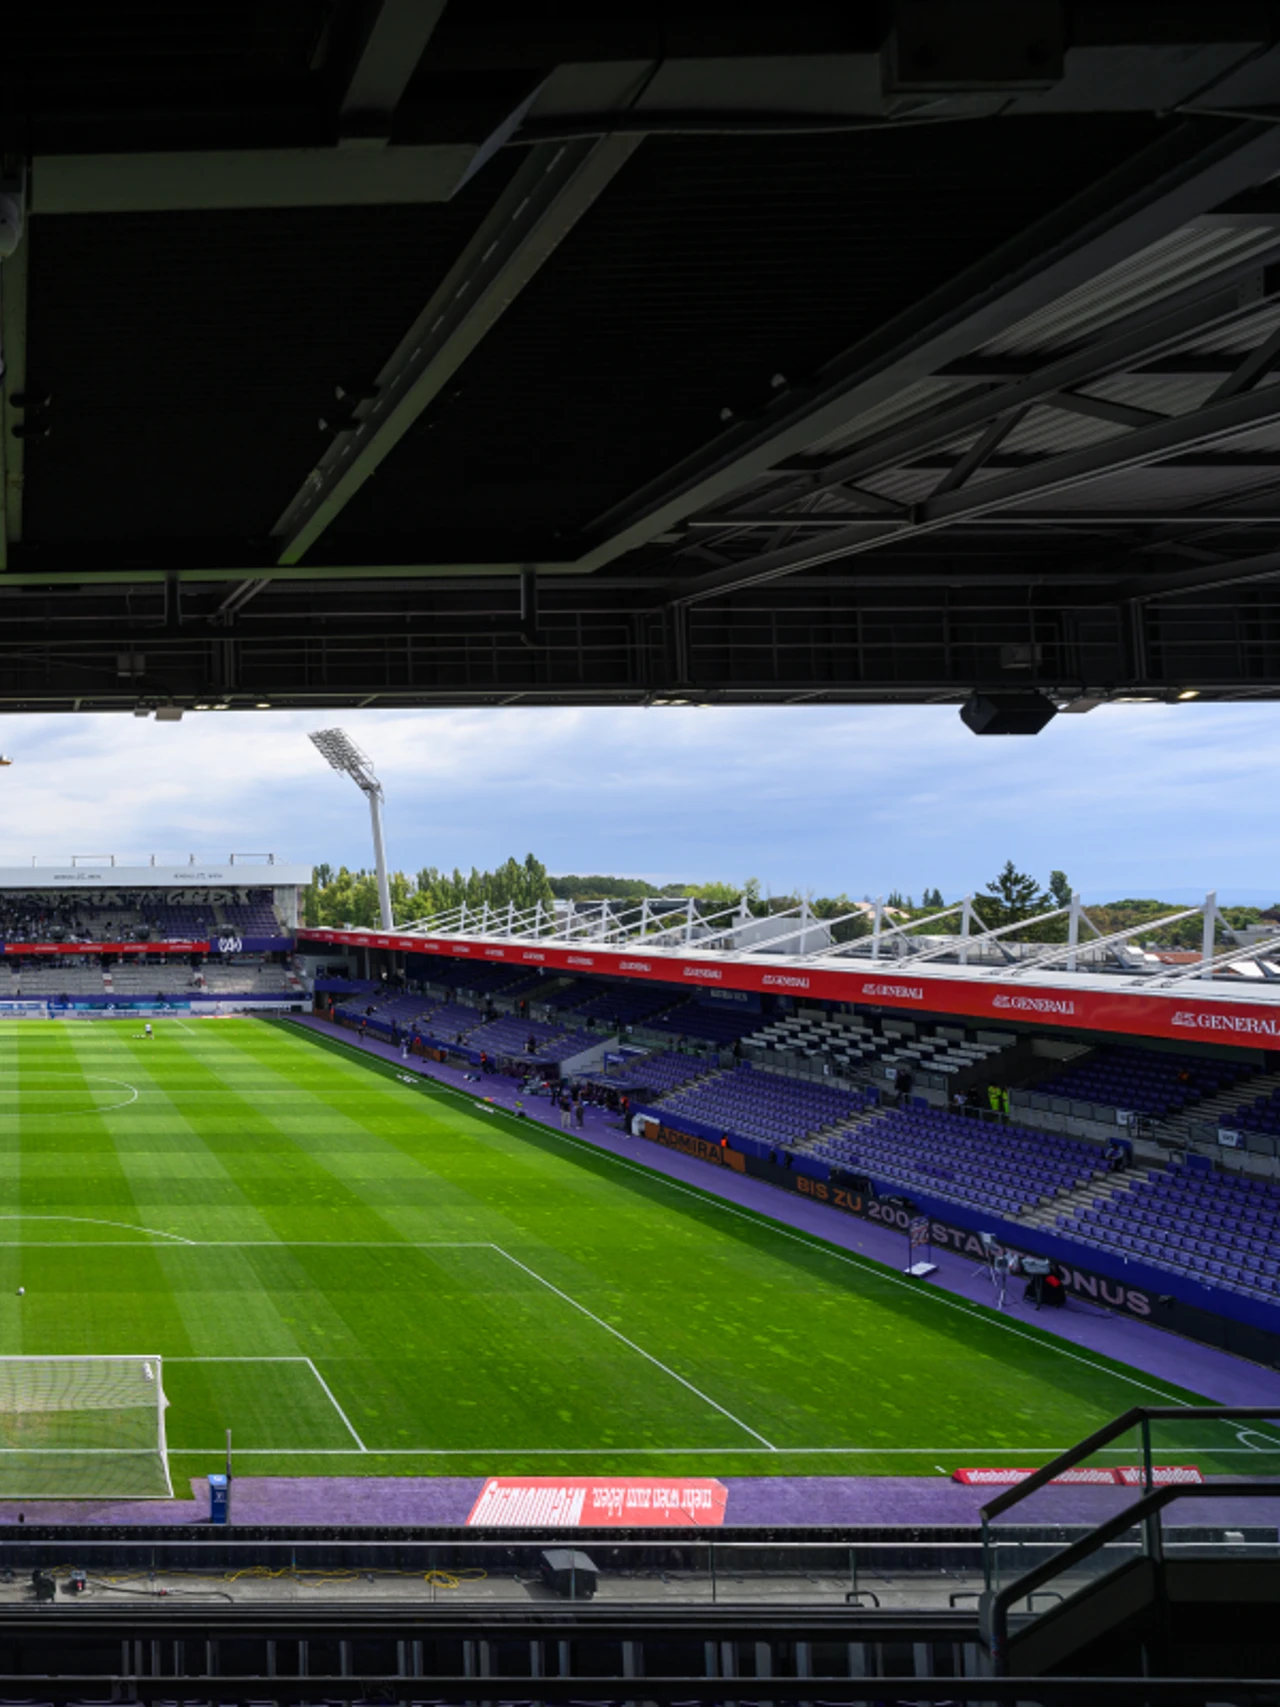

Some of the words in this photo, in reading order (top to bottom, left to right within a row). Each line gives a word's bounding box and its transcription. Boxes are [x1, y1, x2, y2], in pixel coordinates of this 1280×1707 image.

[877, 985, 924, 1000] GENERALI
[1011, 997, 1075, 1015] GENERALI
[796, 1176, 829, 1200] BIS
[832, 1188, 862, 1211] ZU
